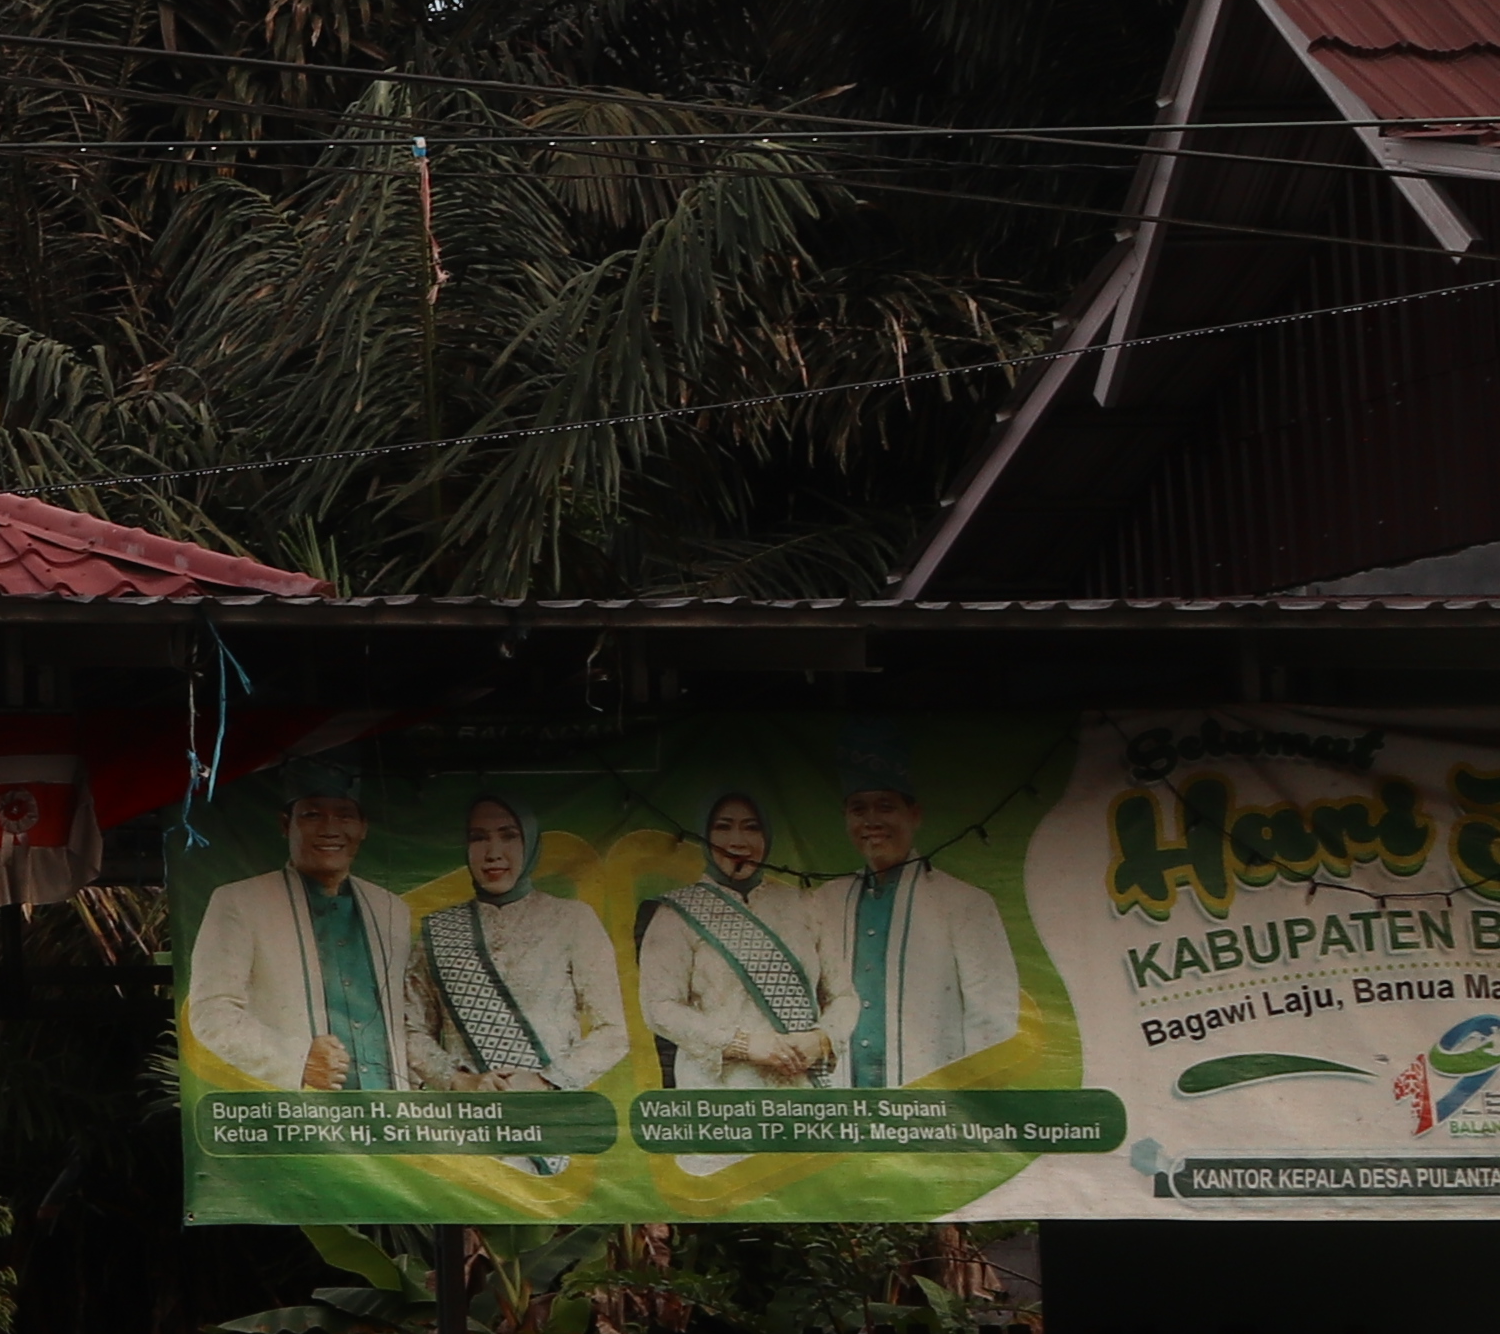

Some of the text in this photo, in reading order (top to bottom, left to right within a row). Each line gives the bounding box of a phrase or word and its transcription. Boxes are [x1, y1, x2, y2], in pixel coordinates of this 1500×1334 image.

[1108, 772, 1436, 920] Hari
[1128, 910, 1456, 989] KABUPATEN
[1141, 995, 1257, 1047] Bagawi
[1263, 984, 1344, 1018] Laju,
[1352, 976, 1454, 1003] Banua
[212, 1100, 503, 1123] Bupati Balangan H. Abdul Hadi
[640, 1099, 947, 1121] Wakil Bupati Balangan H. Supiani
[213, 1124, 543, 1146] Ketua TP.PKK Hj. Sri Huriyati Hadi
[640, 1121, 1102, 1144] Wakil Ketua TP. PKK Hj. Megawati Ulpah Supiani
[1192, 1167, 1500, 1189] KANTOR KEPALA DESA PULANTA
